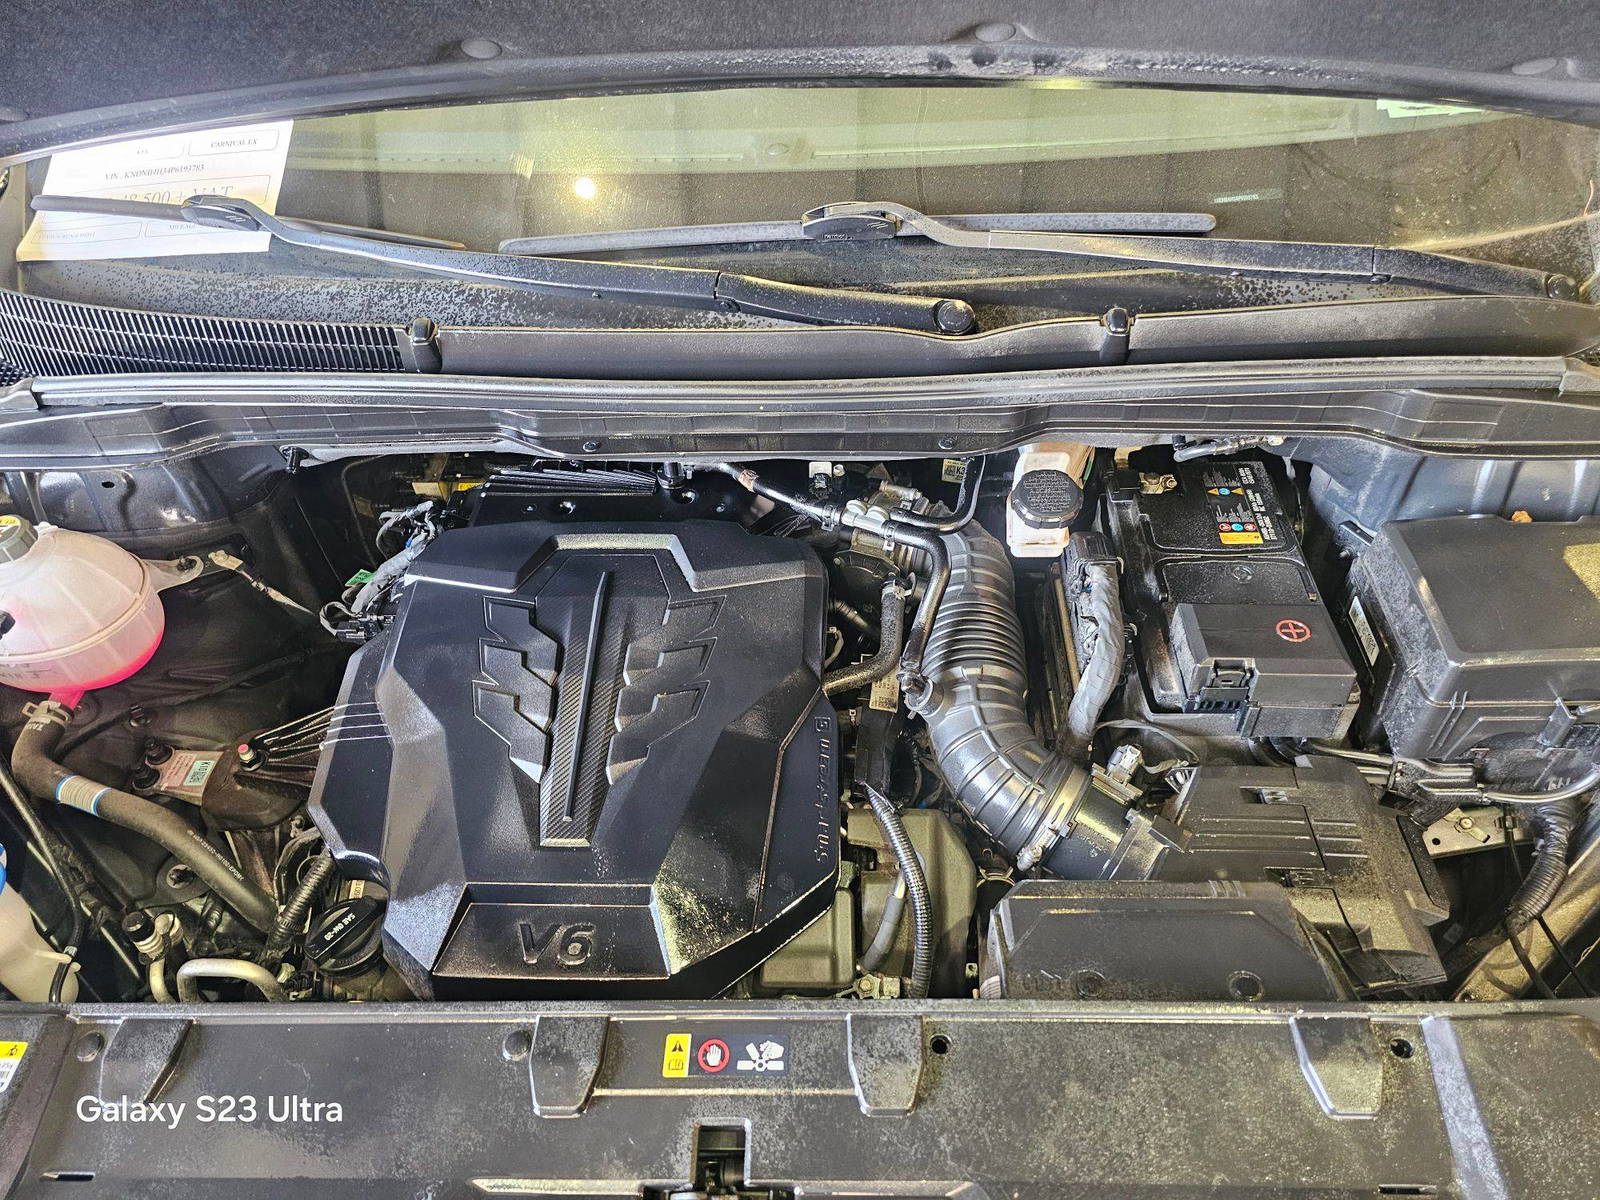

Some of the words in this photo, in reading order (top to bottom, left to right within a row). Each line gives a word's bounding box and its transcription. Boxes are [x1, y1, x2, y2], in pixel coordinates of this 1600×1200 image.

[210, 139, 245, 149] CARNIVAL
[814, 738, 831, 863] Smartstream
[341, 912, 356, 925] SAE
[518, 921, 596, 966] V6
